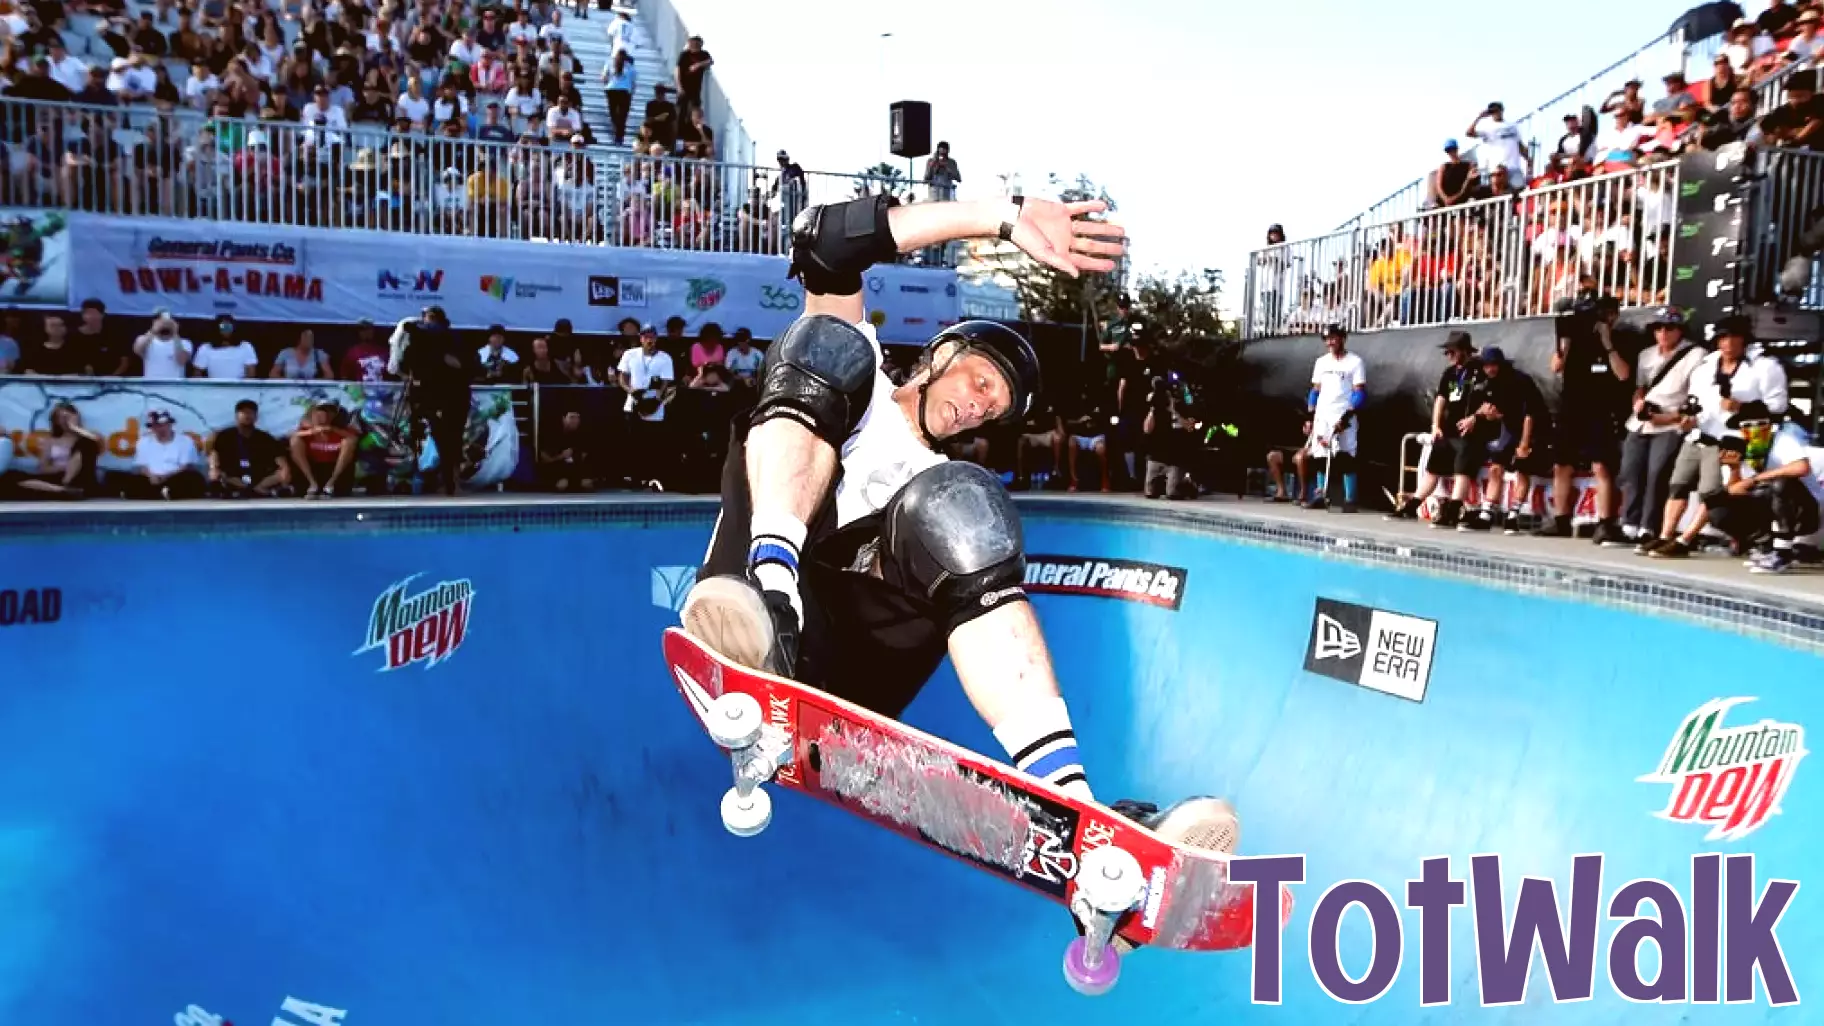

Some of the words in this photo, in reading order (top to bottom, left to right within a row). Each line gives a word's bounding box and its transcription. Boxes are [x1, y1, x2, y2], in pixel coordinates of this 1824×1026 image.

[218, 239, 269, 259] Pants
[759, 285, 800, 311] 360
[1023, 561, 1092, 586] neral
[1088, 563, 1152, 592] Pants
[368, 582, 470, 646] Mountain
[1377, 628, 1425, 659] NEW
[1372, 651, 1421, 682] ERA
[1660, 708, 1799, 776] Mountain
